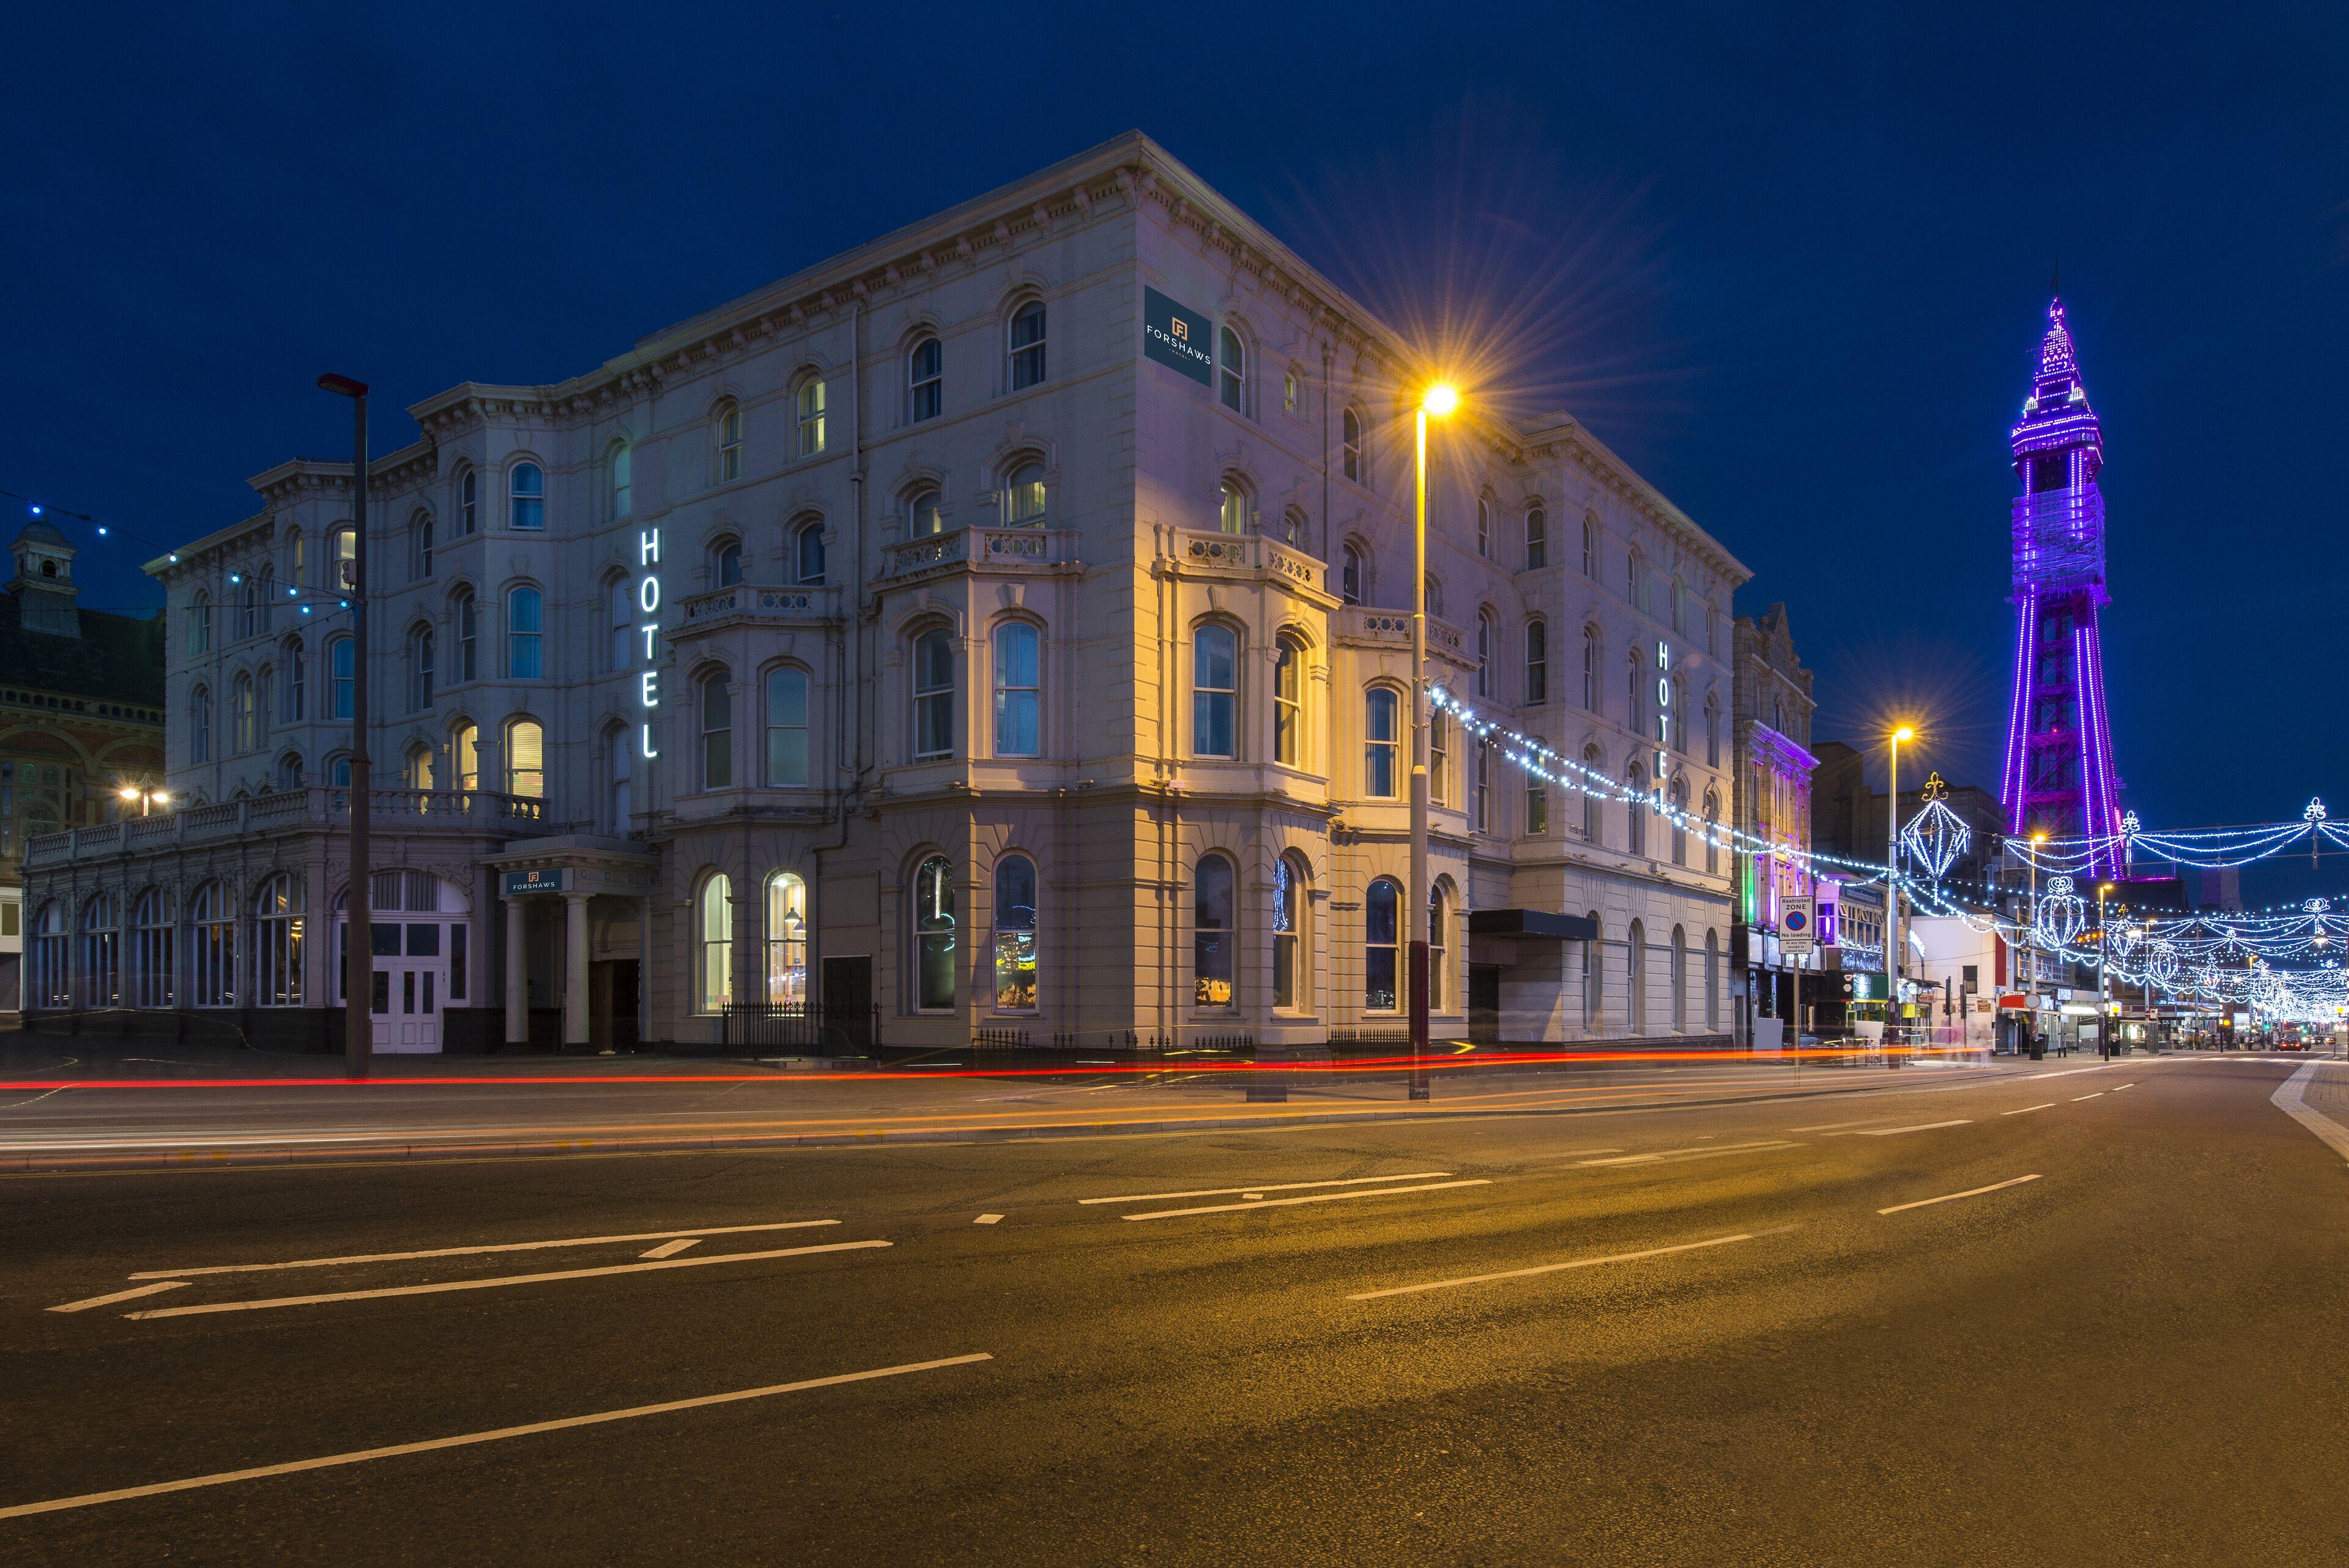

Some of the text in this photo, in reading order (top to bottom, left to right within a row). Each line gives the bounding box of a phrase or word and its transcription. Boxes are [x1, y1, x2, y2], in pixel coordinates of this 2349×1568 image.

[1147, 324, 1211, 365] FORSHAWS
[1171, 349, 1187, 360] HOTEL
[641, 528, 659, 759] HOTEL
[1659, 641, 1669, 815] HOTEL
